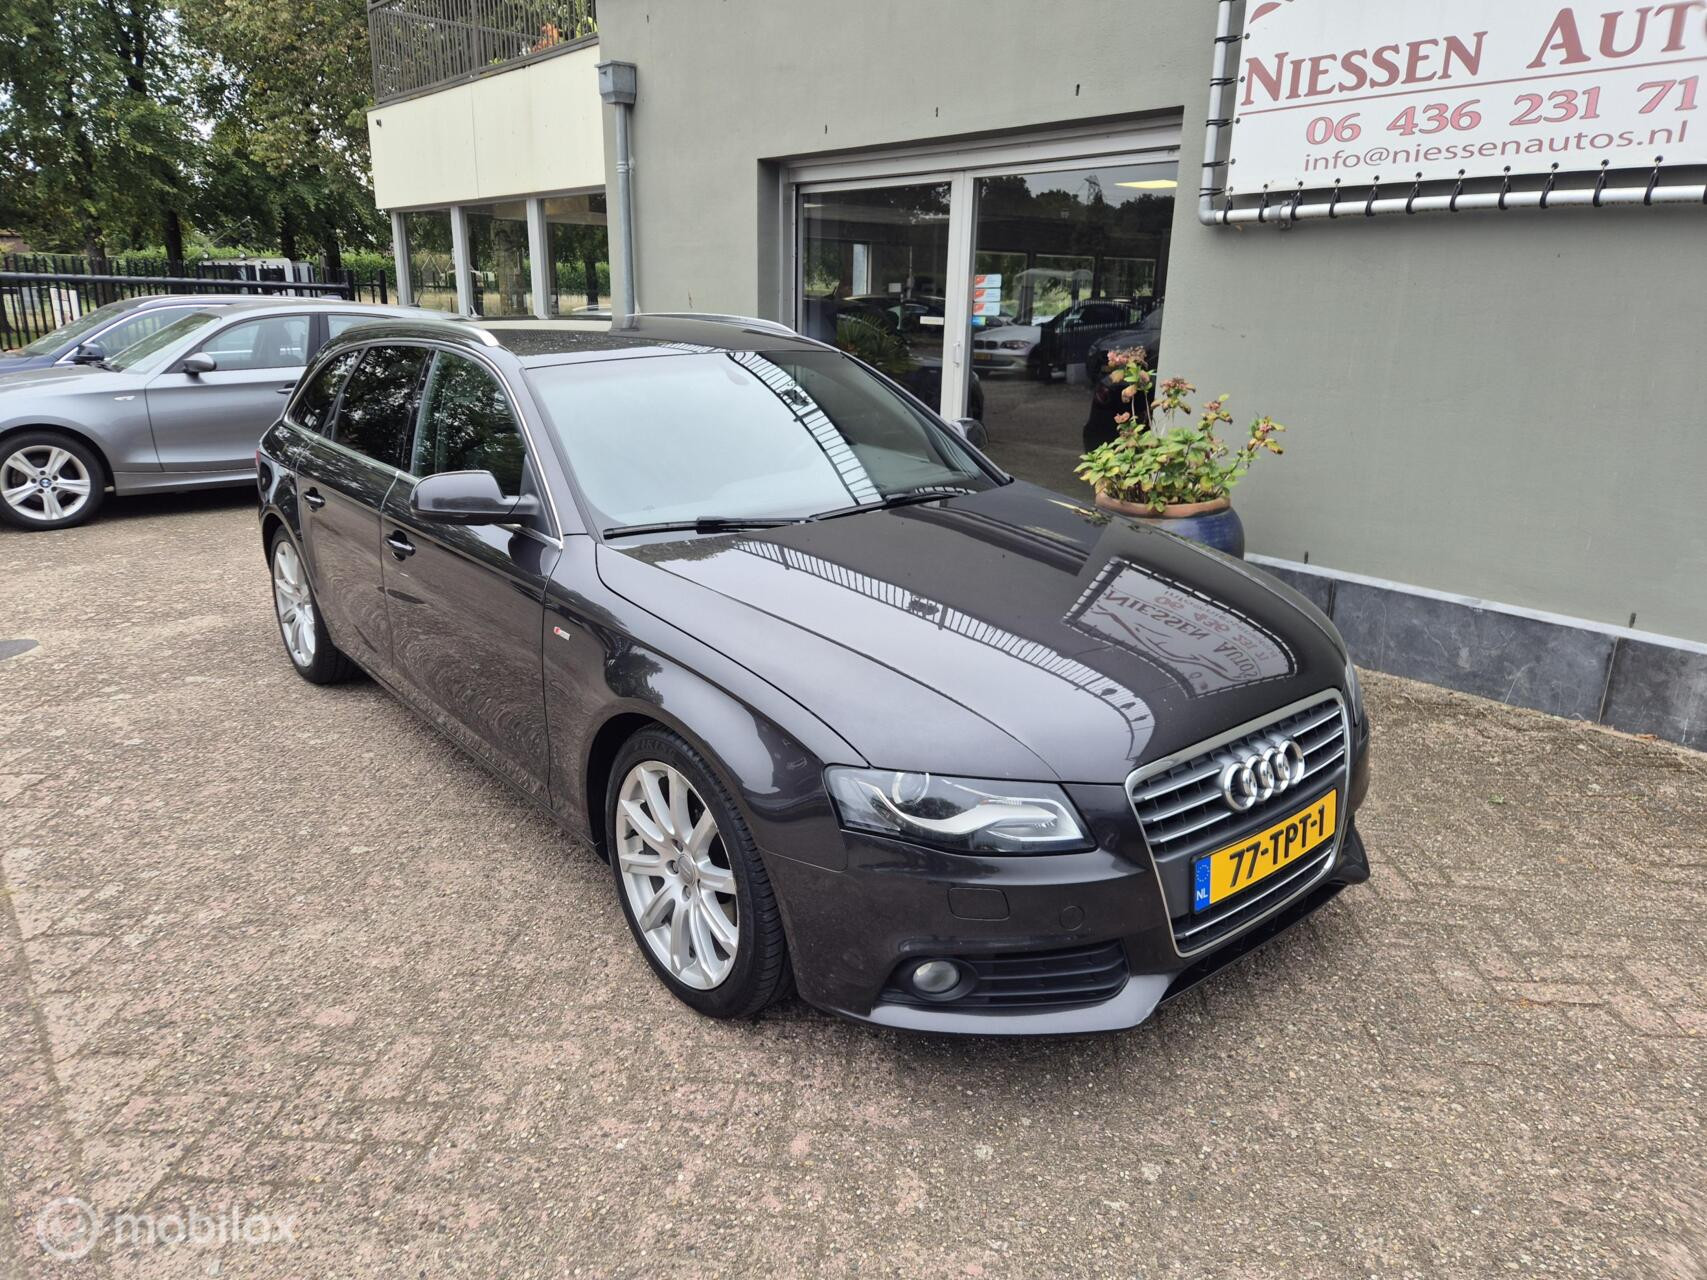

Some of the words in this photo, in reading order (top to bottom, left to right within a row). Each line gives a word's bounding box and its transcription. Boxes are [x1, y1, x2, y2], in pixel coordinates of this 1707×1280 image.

[1242, 31, 1488, 106] NIESSEN
[1526, 1, 1707, 69] AUT
[1306, 113, 1361, 145] 06
[1387, 100, 1482, 136] 436
[1509, 86, 1600, 126] 231
[1637, 75, 1699, 114] 71
[1304, 121, 1687, 172] info@niessenautos.nl
[1230, 805, 1325, 888] 77-TPT-1
[1196, 889, 1208, 901] NL
